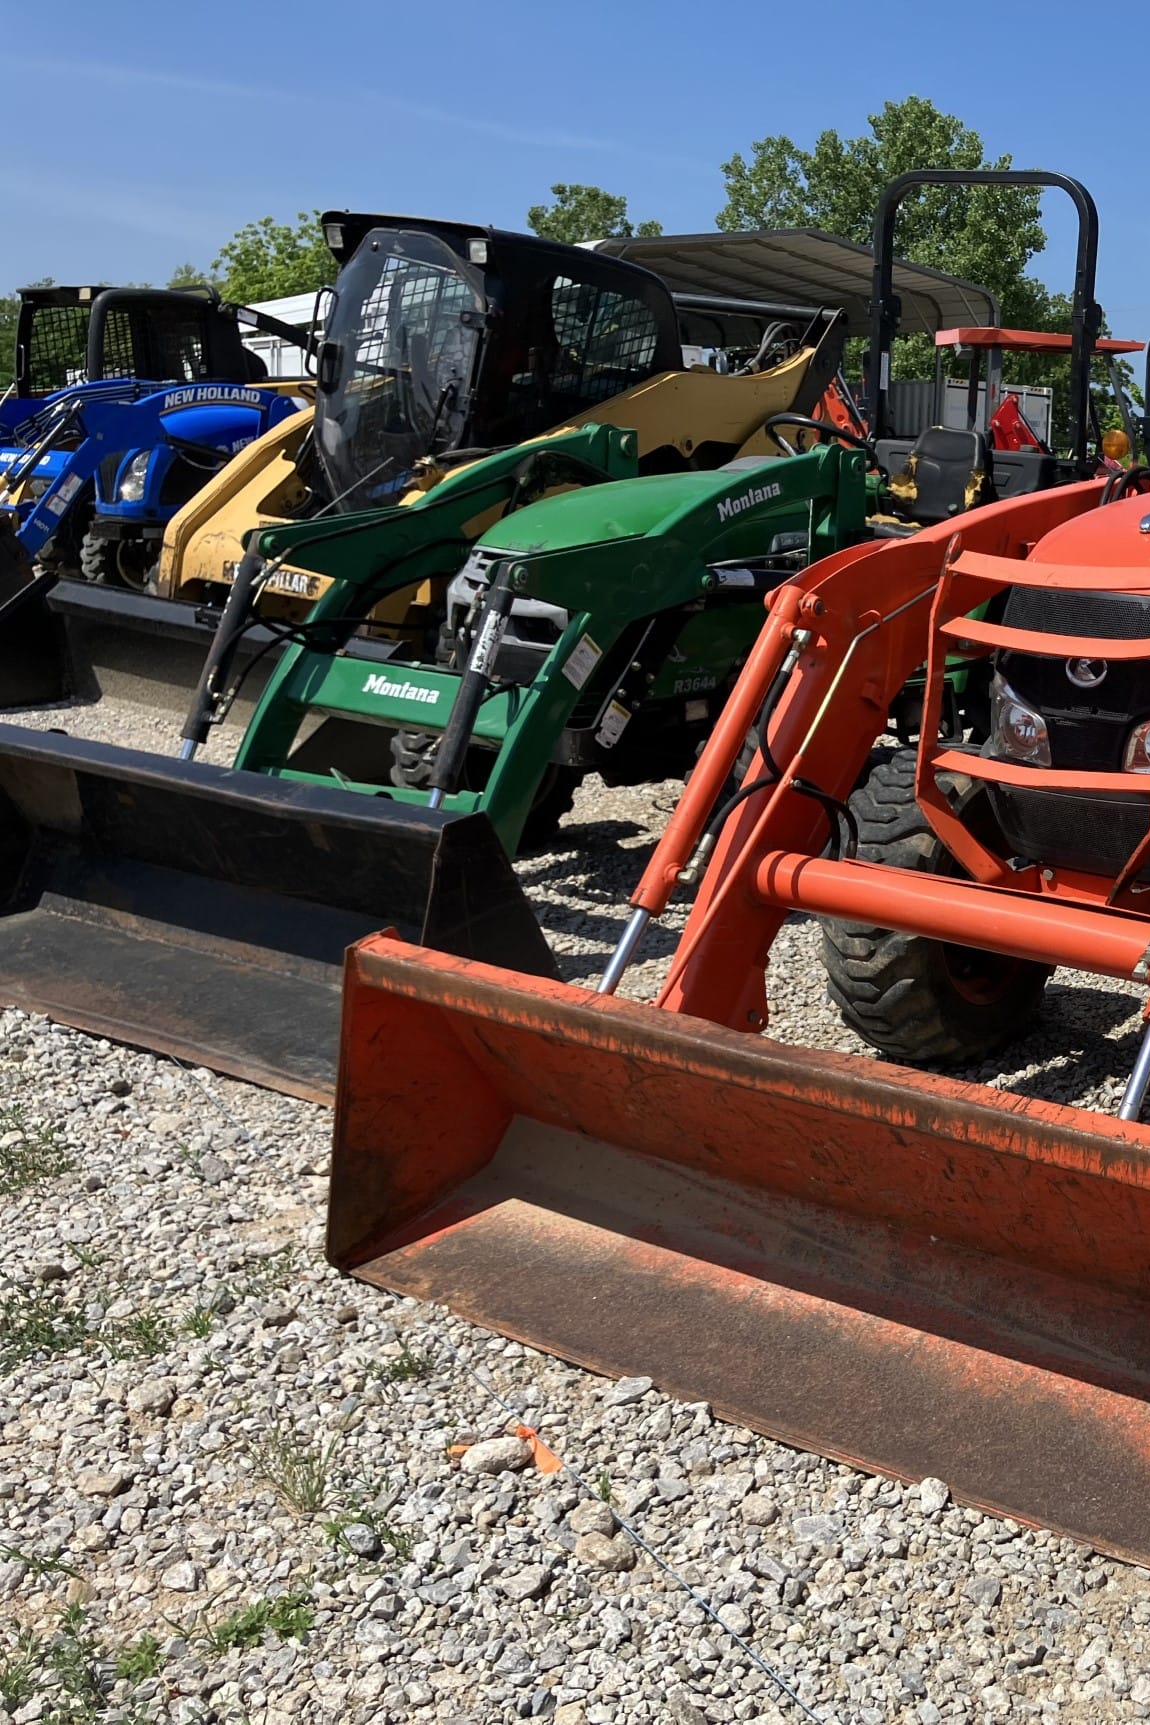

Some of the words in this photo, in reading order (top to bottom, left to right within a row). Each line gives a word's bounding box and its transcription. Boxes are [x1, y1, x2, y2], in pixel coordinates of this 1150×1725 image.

[164, 387, 195, 409] NEW
[197, 386, 261, 404] HOLLAND
[717, 482, 781, 523] Montana
[362, 673, 440, 704] Montana
[673, 676, 717, 695] R3644
